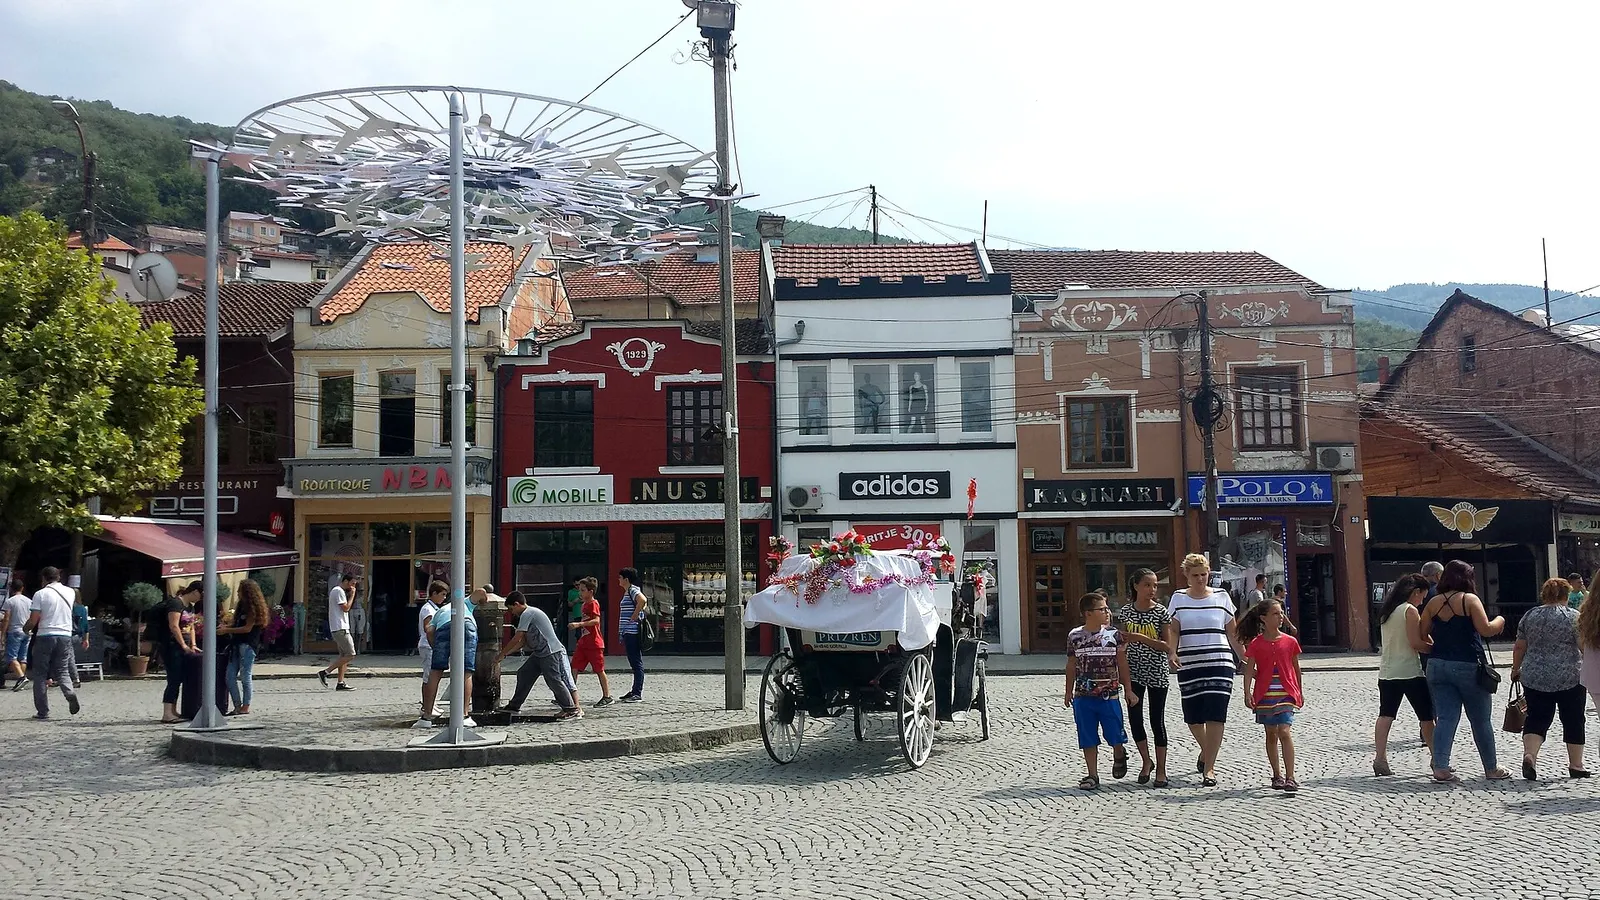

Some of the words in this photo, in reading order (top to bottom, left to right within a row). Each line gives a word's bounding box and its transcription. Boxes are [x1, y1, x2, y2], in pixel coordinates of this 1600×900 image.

[625, 350, 647, 359] 1929
[179, 480, 259, 491] RESTURANT
[300, 478, 371, 491] BOUTIQUE
[851, 474, 940, 496] adidas
[1216, 478, 1306, 497] POLO
[542, 488, 607, 504] MOBILE
[1033, 487, 1164, 505] KAQINARI
[685, 535, 755, 546] FILIGN
[1087, 532, 1158, 545] FILIGRAN
